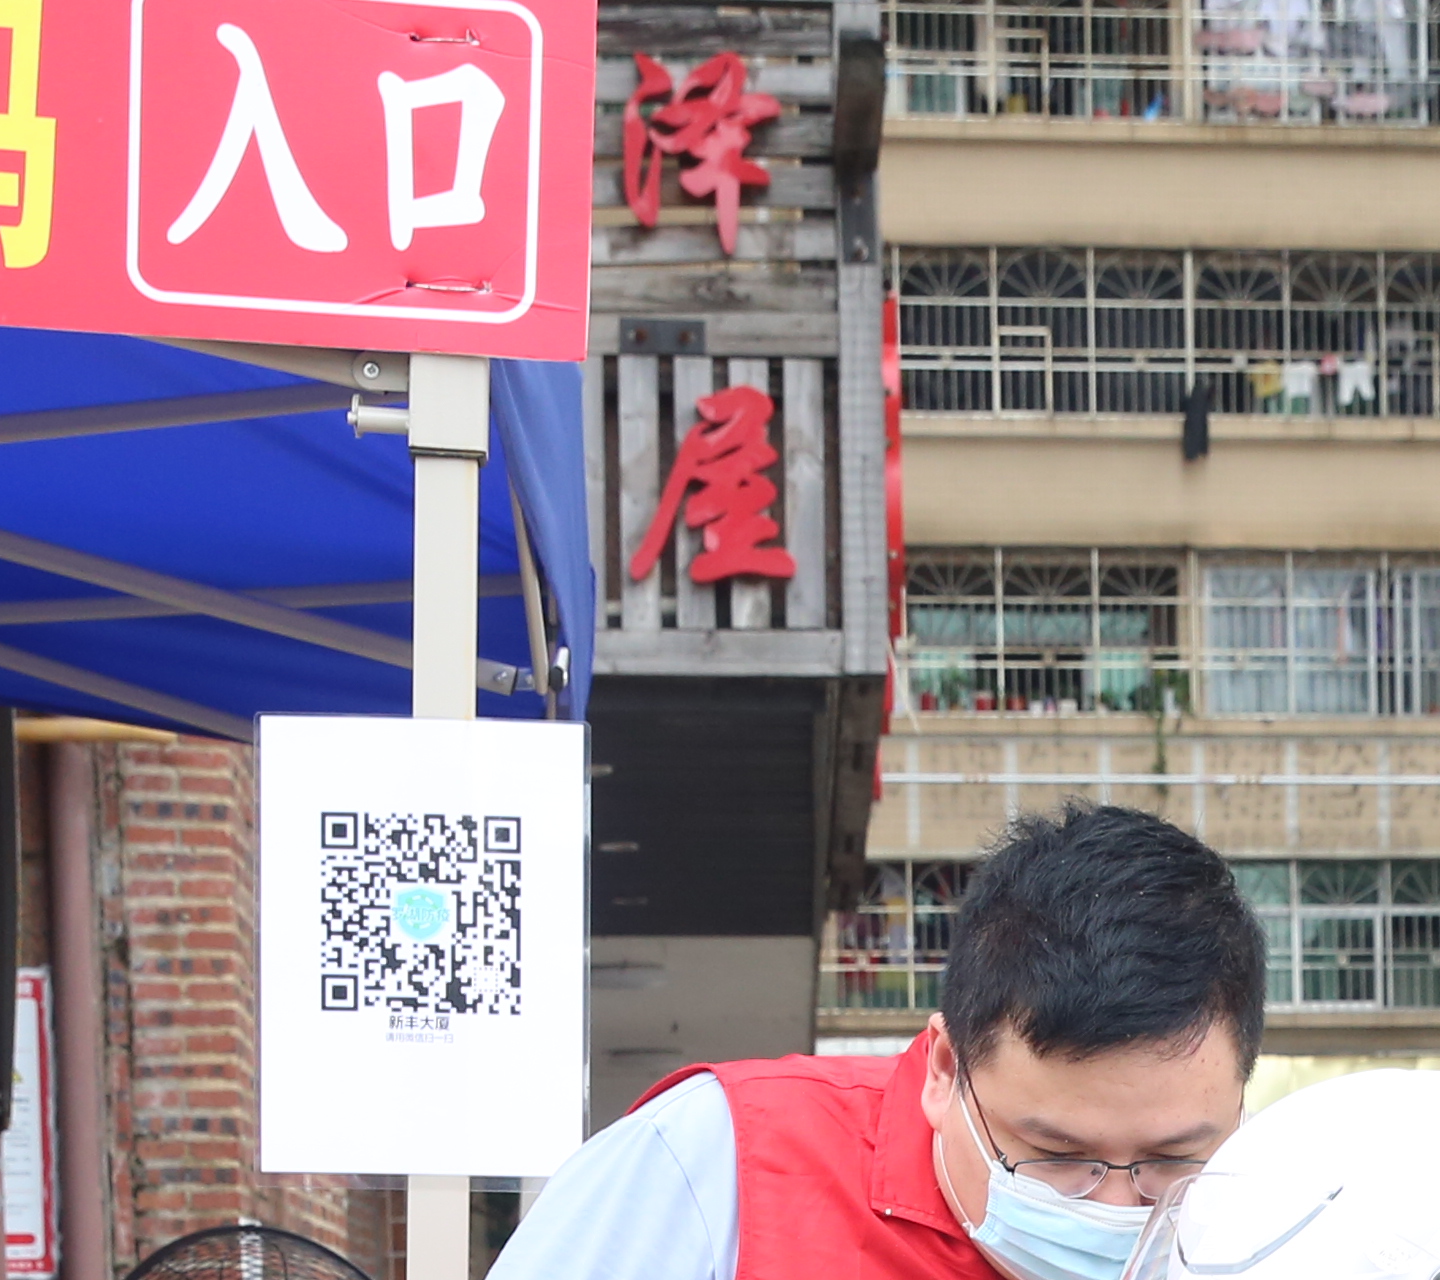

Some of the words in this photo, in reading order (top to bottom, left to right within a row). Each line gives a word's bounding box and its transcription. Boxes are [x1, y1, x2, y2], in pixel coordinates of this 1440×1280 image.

[166, 22, 507, 253] 入口
[389, 1015, 449, 1030] 新丰大厦
